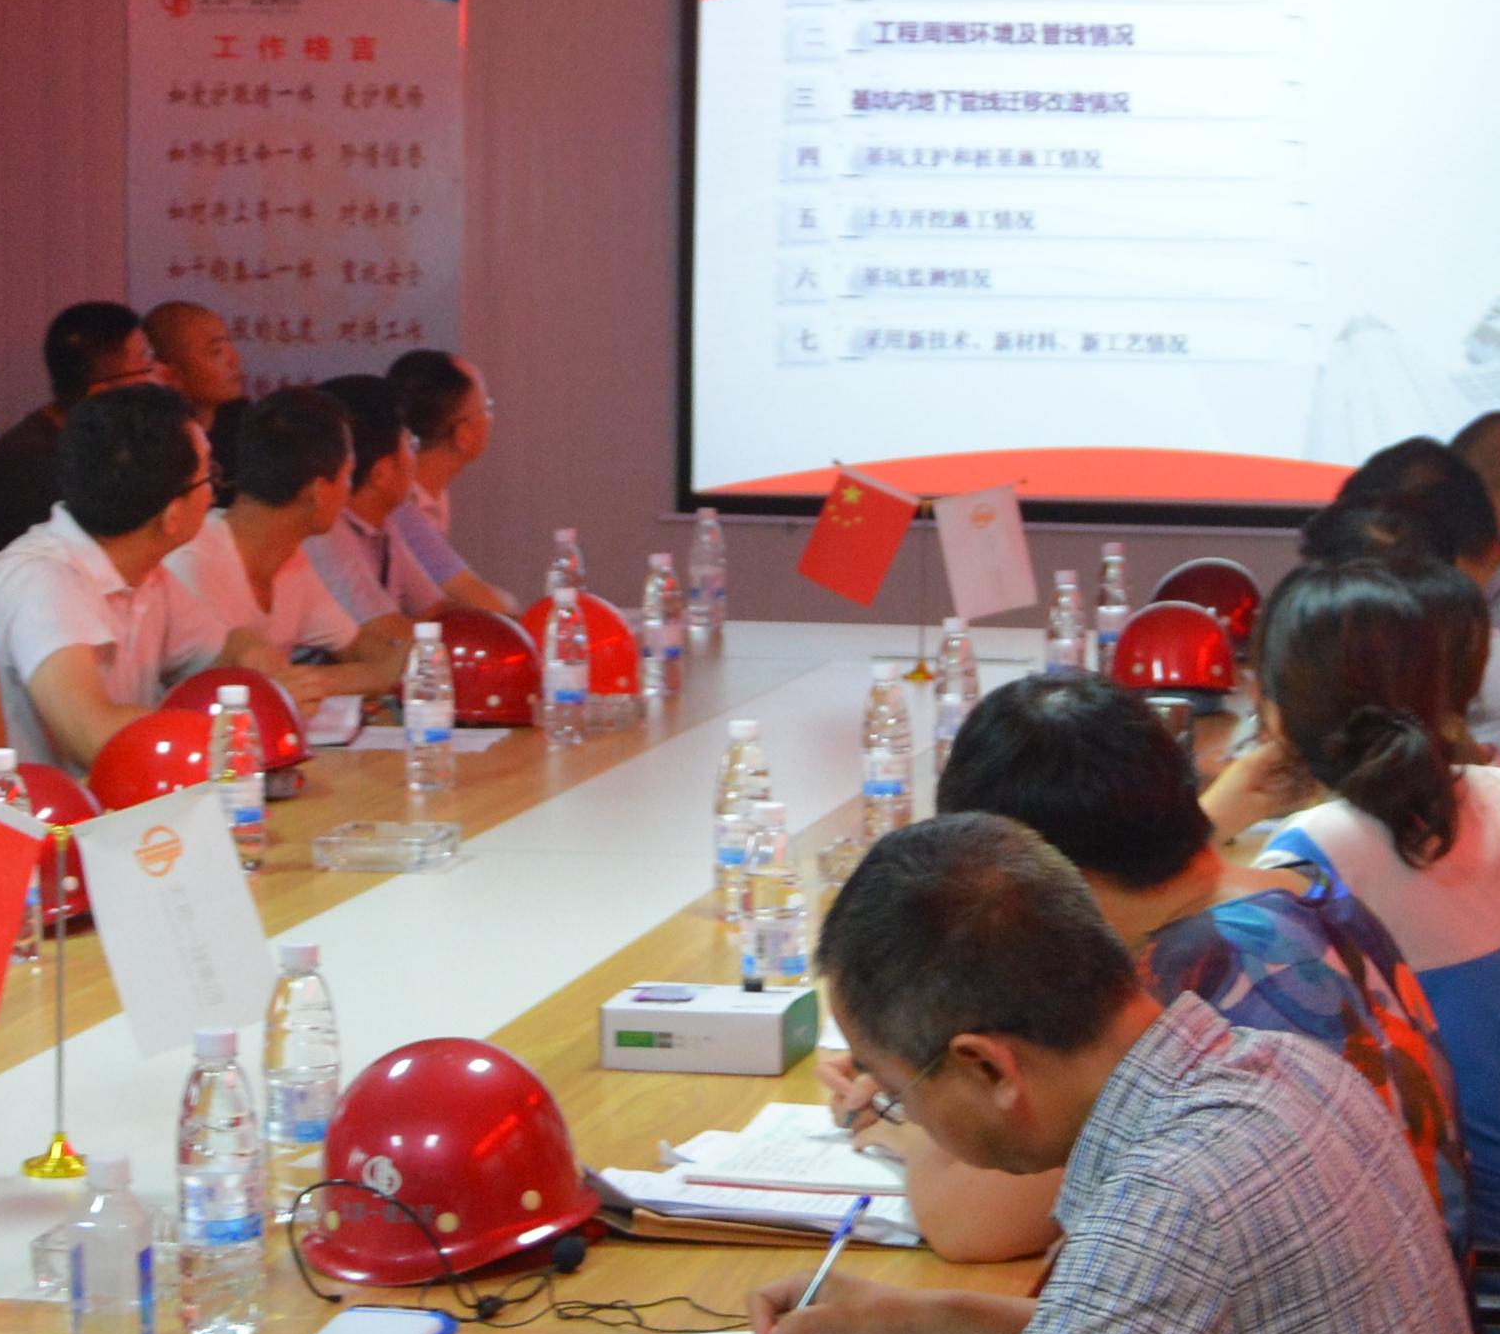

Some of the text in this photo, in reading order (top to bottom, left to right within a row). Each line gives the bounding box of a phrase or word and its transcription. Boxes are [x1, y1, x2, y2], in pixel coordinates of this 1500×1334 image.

[874, 20, 1134, 46] 工程周围环境及管线情况
